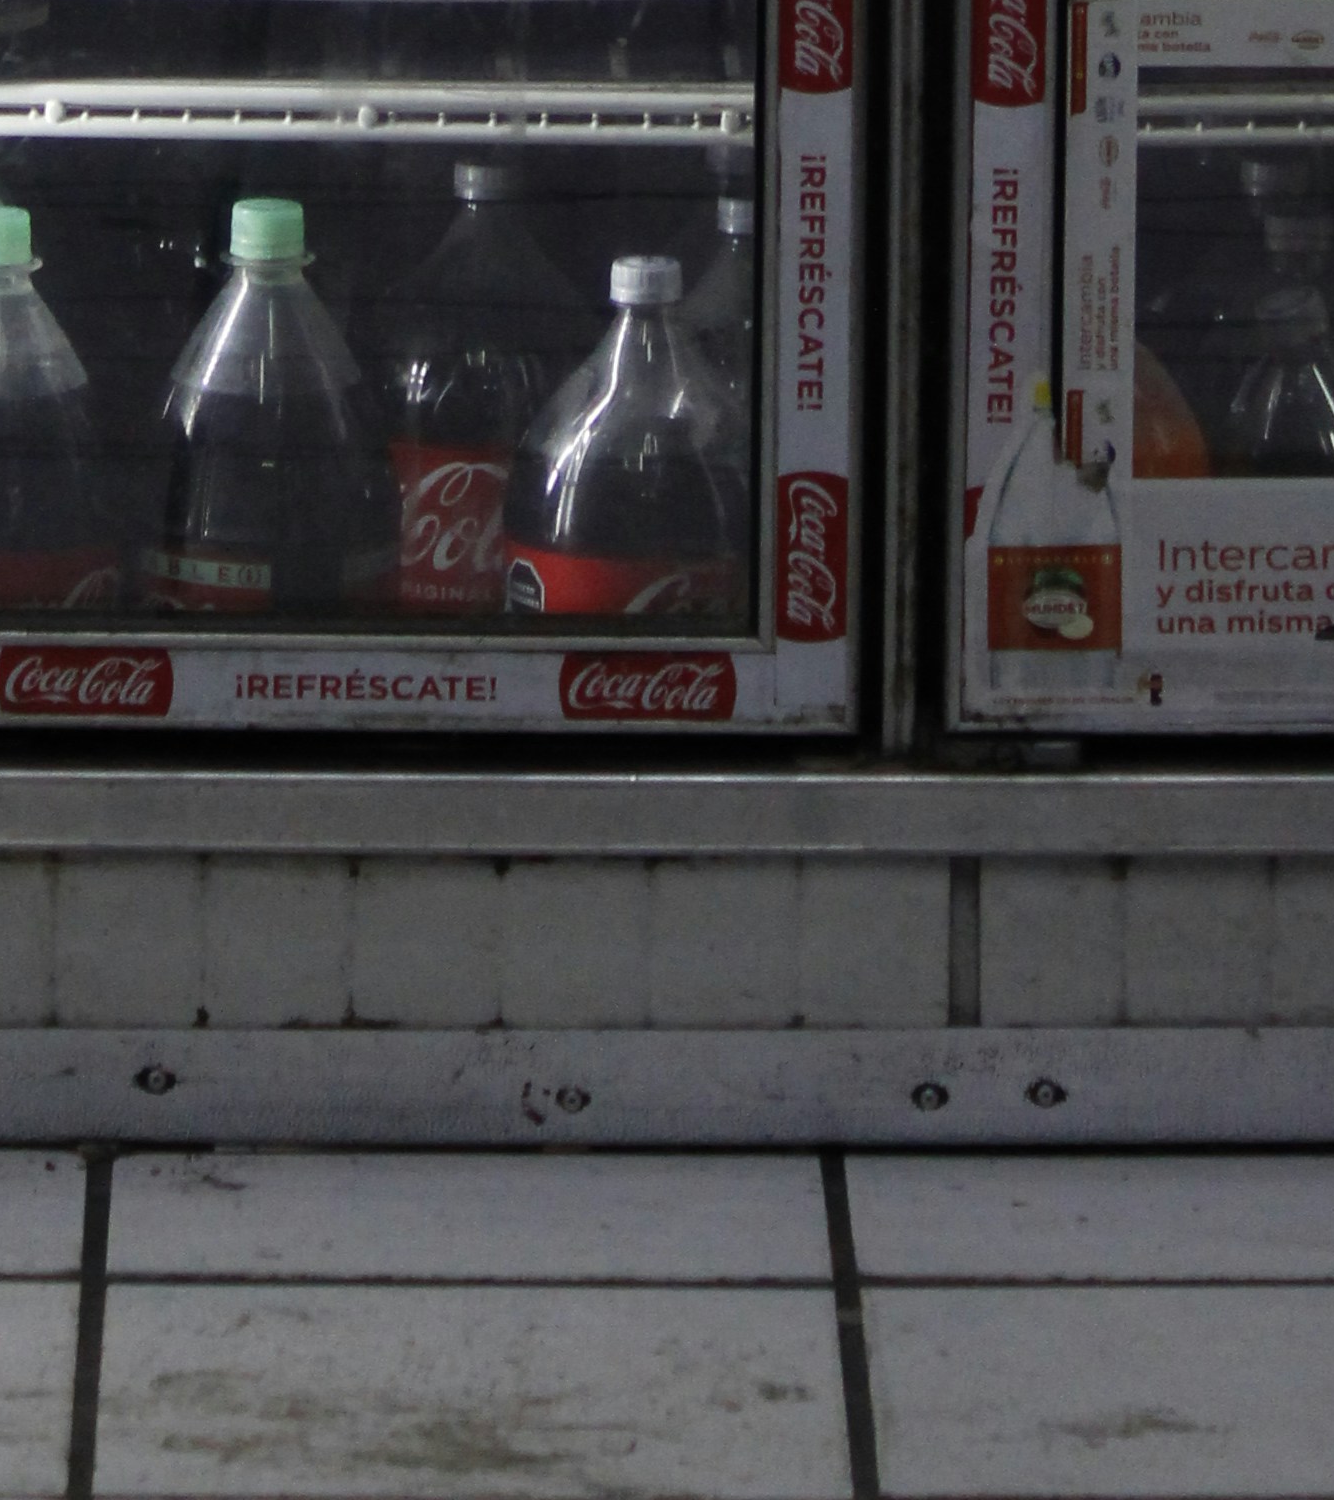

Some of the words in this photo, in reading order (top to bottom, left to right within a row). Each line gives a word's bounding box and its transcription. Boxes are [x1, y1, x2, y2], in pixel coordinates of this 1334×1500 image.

[796, 154, 826, 412] ¡REFRÉSCATE!
[1156, 586, 1173, 606] y
[1186, 579, 1314, 602] disfruta
[1158, 616, 1215, 634] una
[1228, 611, 1331, 633] misma
[5, 655, 157, 707] Coca-Cola
[236, 668, 497, 702] ¡REFRÉSCATE!
[568, 659, 718, 713] Coca-Cola
